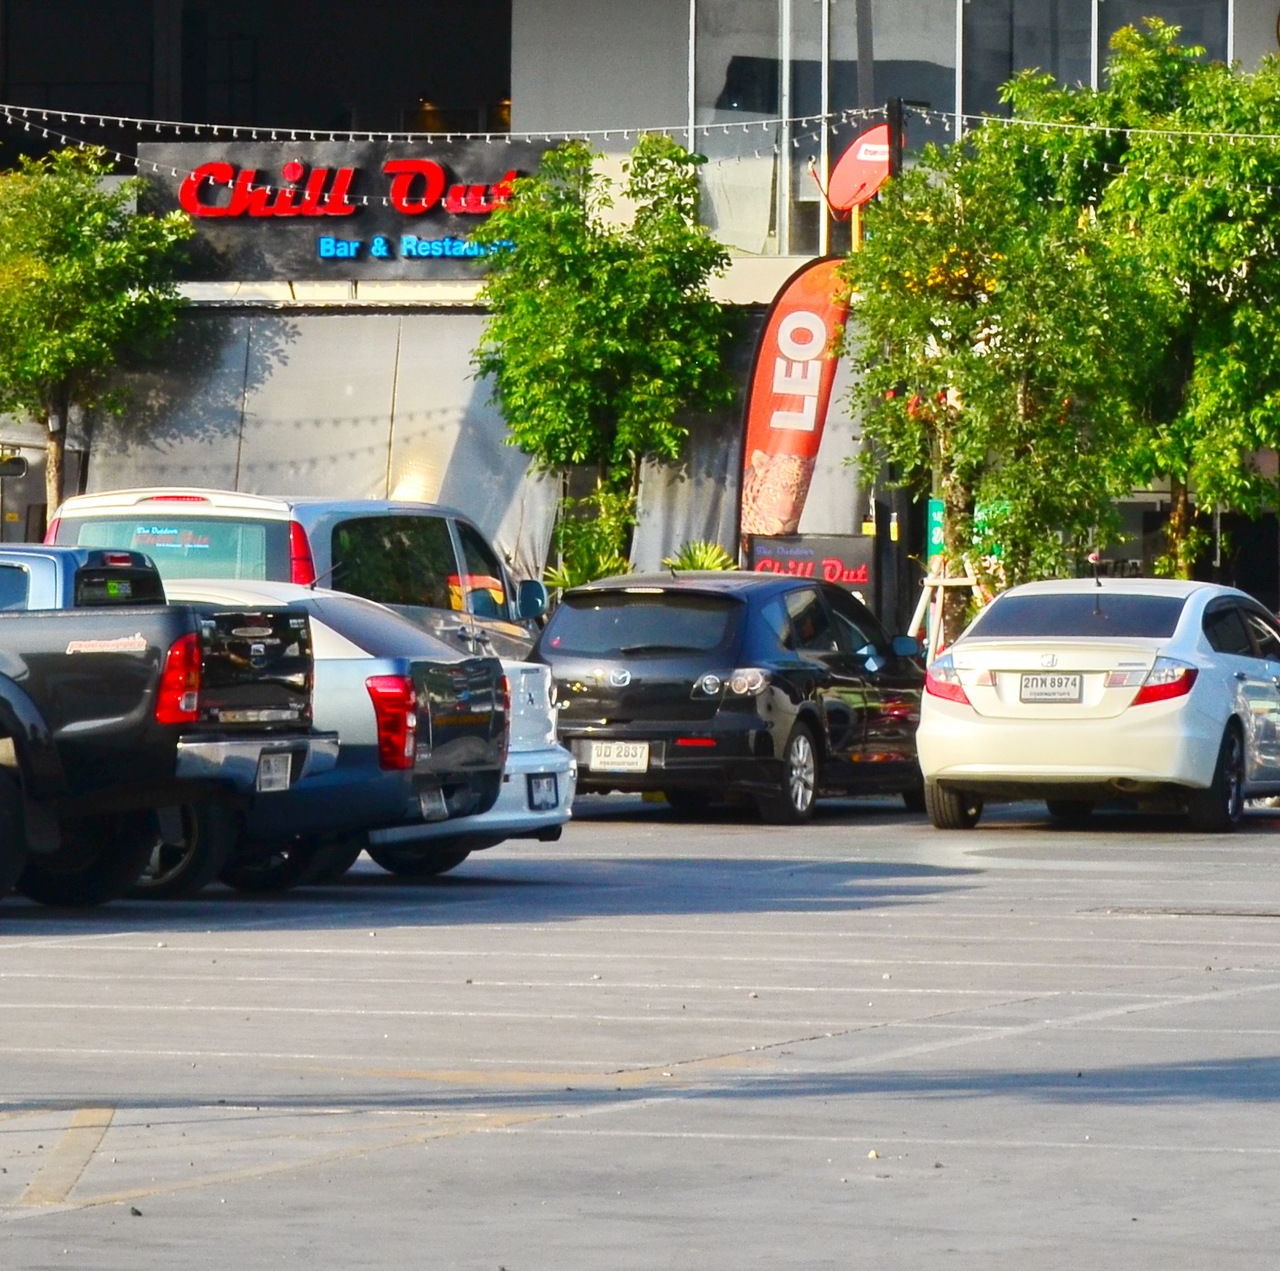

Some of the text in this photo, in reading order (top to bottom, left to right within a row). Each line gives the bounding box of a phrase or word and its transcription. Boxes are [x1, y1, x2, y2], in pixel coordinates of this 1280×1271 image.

[178, 160, 358, 217] Chill
[319, 236, 359, 258] Bar
[370, 236, 388, 258] &
[770, 310, 827, 431] LEO
[821, 557, 869, 584] Out
[1050, 677, 1078, 689] 8974
[615, 745, 646, 758] 2837
